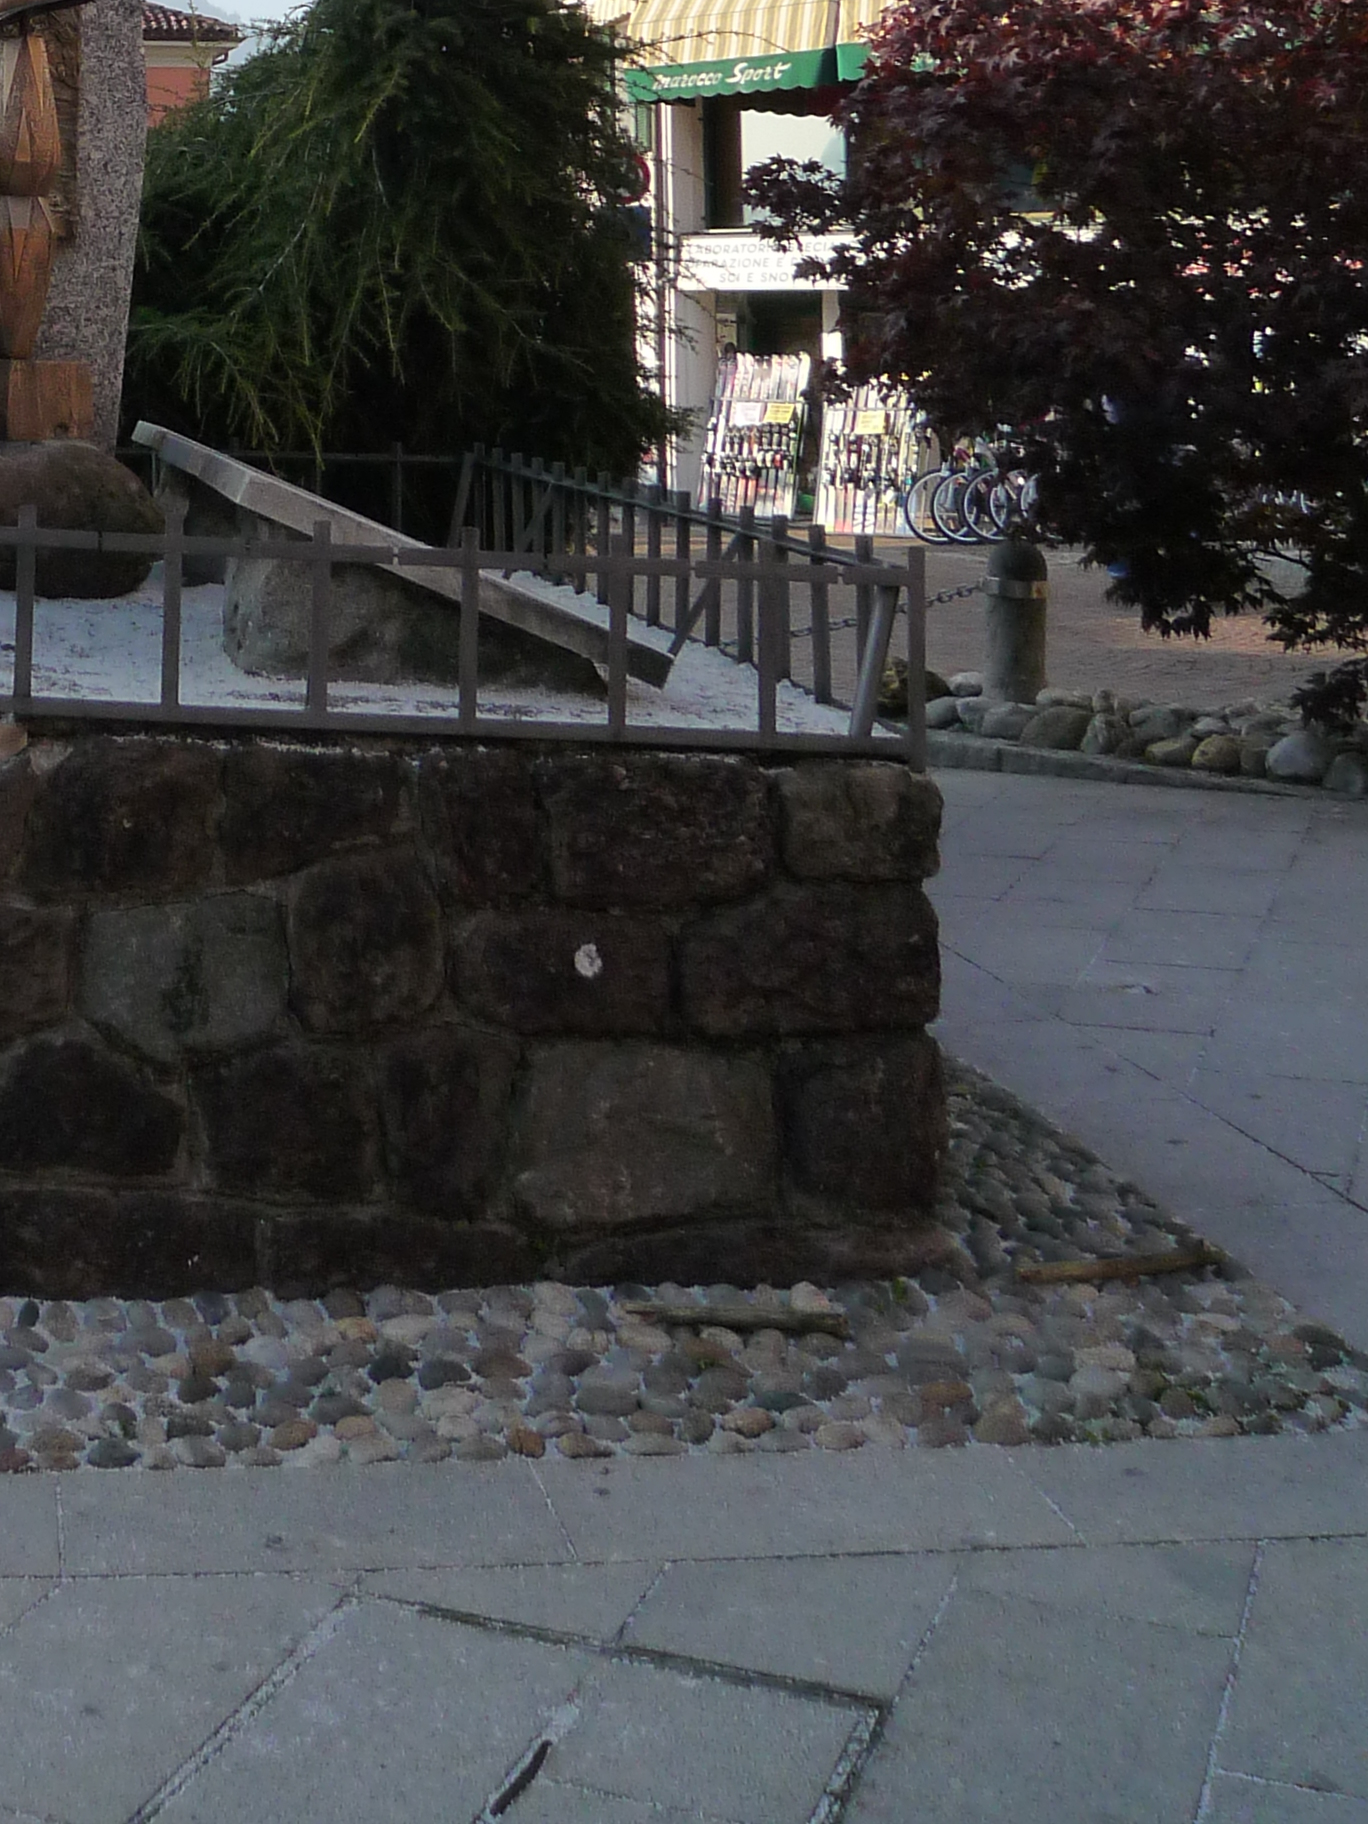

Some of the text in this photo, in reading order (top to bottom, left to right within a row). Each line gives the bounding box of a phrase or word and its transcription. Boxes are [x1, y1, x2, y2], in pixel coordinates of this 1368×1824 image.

[724, 61, 792, 84] Sport
[686, 242, 779, 255] LABORATORI
[719, 272, 740, 283] SCI
[760, 271, 790, 283] SNO
